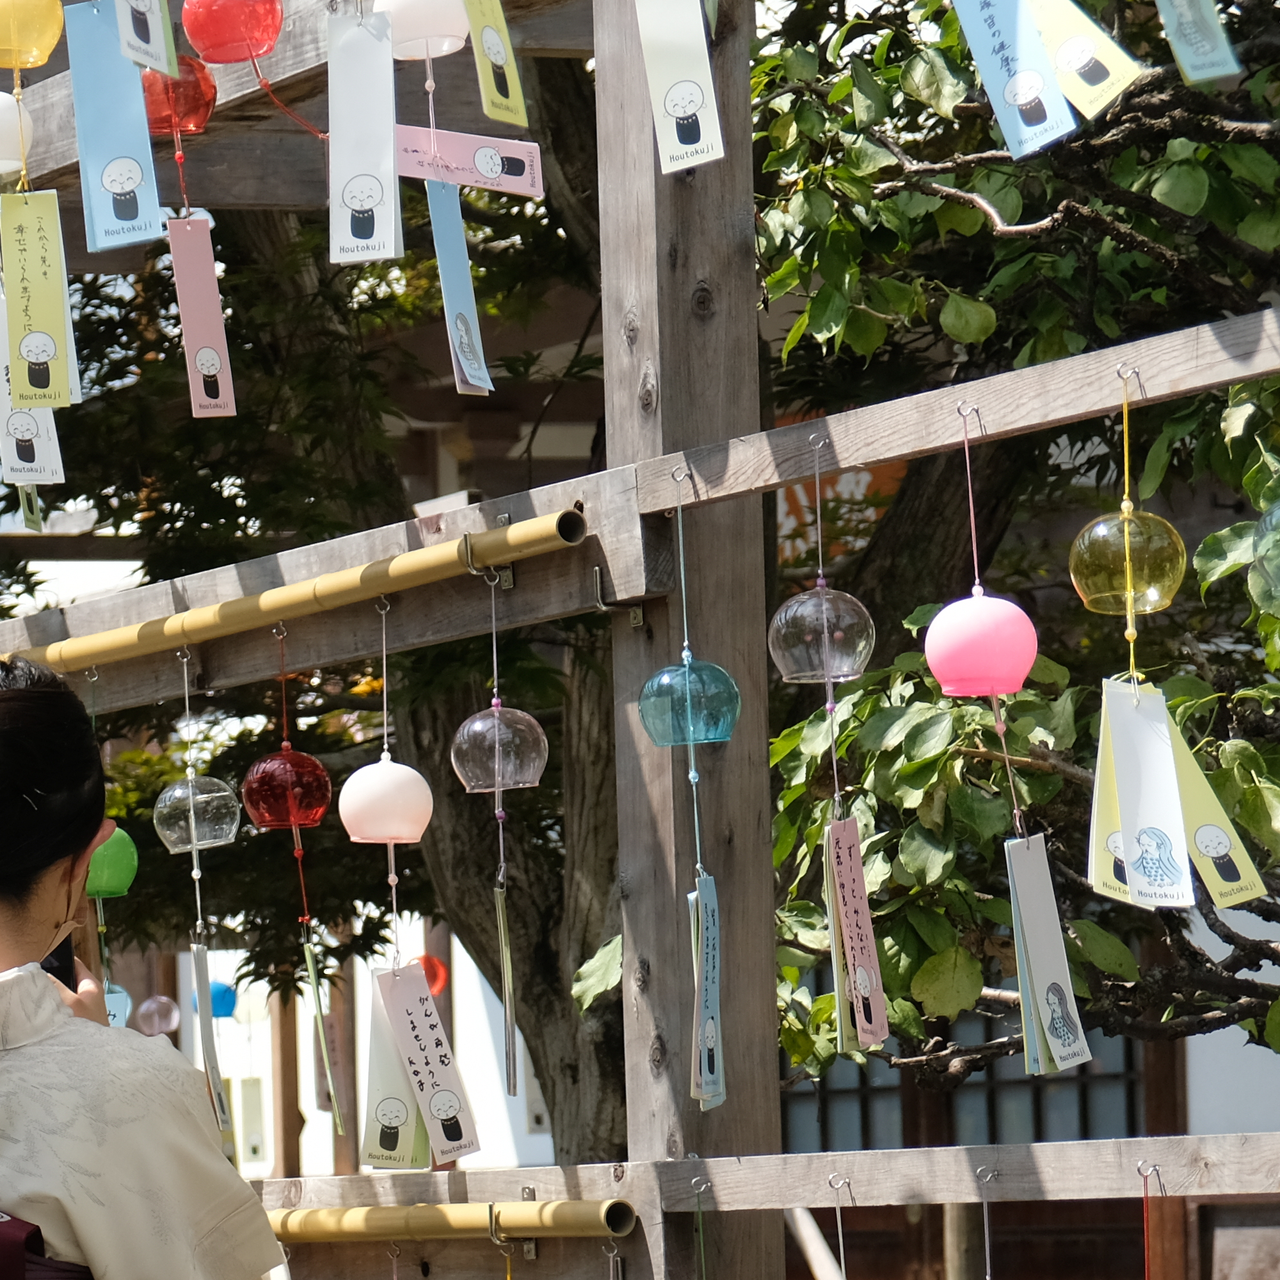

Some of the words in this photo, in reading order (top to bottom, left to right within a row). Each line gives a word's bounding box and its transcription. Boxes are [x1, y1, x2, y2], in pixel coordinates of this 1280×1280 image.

[127, 40, 163, 63] Houtokuji
[1087, 69, 1130, 106] Houtokuji
[1017, 118, 1065, 148] Houtokuji
[669, 142, 716, 165] Houtokuji
[103, 219, 154, 239] Houtokuji
[339, 241, 387, 256] Houtokuji
[18, 392, 62, 402] Houtokuji
[198, 402, 230, 412] Houtokuji
[9, 465, 46, 474] Houtokuji
[1137, 889, 1186, 901] Houtokuji
[1218, 881, 1258, 900] Houtokuji
[1059, 1047, 1086, 1063] Houtokuji
[440, 1140, 476, 1157] Houtokuji
[368, 1152, 406, 1163] Houtokuji
